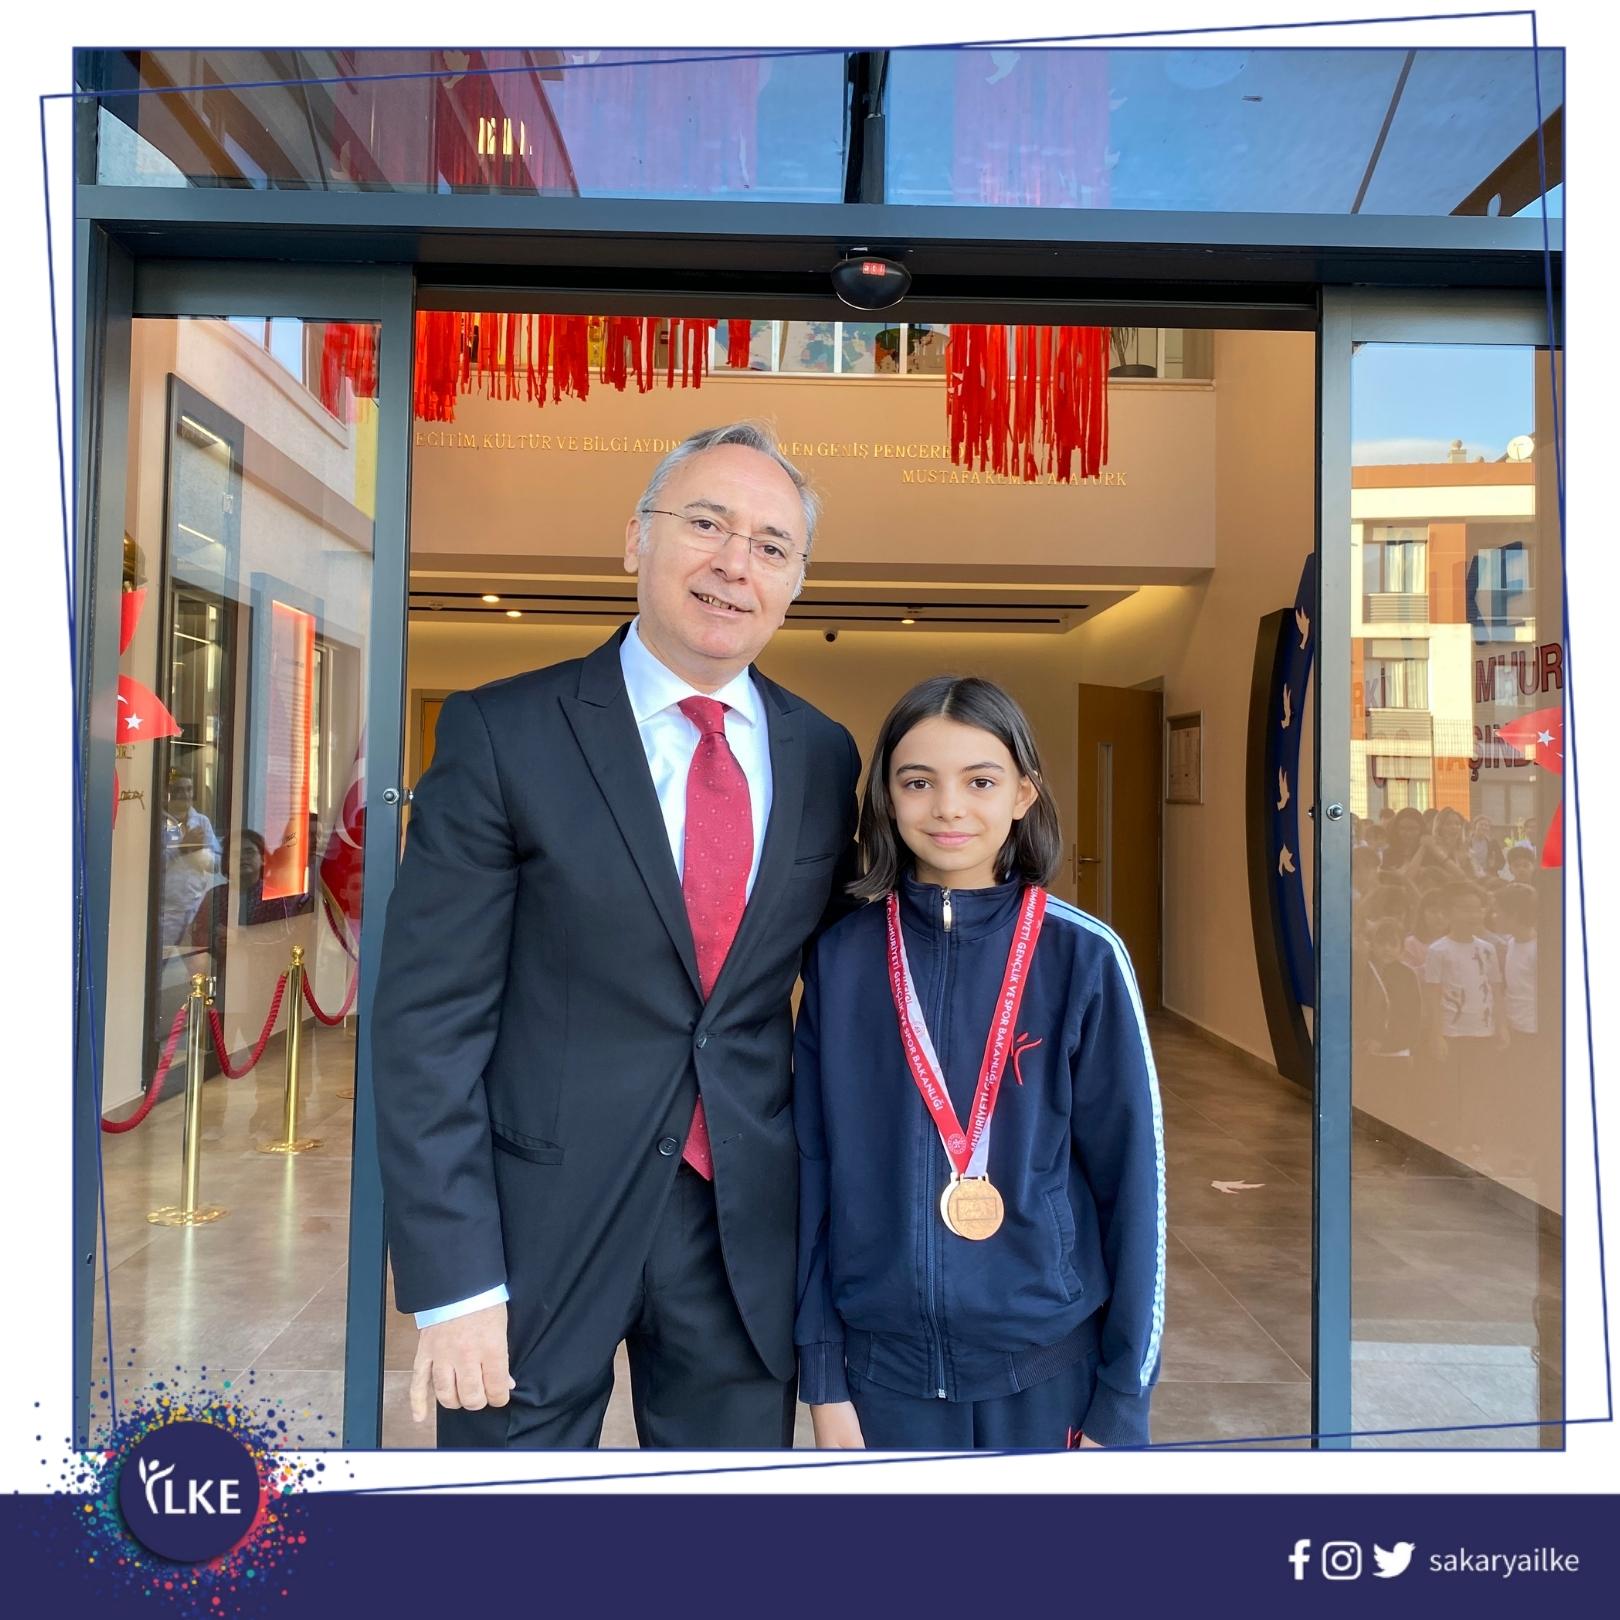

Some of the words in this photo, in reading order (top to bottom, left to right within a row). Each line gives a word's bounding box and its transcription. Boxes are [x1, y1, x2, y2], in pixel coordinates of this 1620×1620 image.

[483, 432, 551, 450] KÜLTÜR
[557, 436, 578, 451] VE
[583, 436, 628, 452] BİLGİ
[632, 439, 681, 454] AYDIN
[792, 442, 814, 457] EN
[817, 442, 869, 459] GENİŞ
[902, 470, 981, 485] MUSTAFA
[985, 471, 1044, 486] KEML
[1009, 942, 1027, 984] GENÇLİK
[1006, 985, 1017, 999] VE
[999, 999, 1014, 1026] SPOR
[903, 1027, 917, 1055] SPOR
[912, 1055, 944, 1111] BAKANLIĞI
[988, 1027, 1008, 1085] BAKANLIĞI
